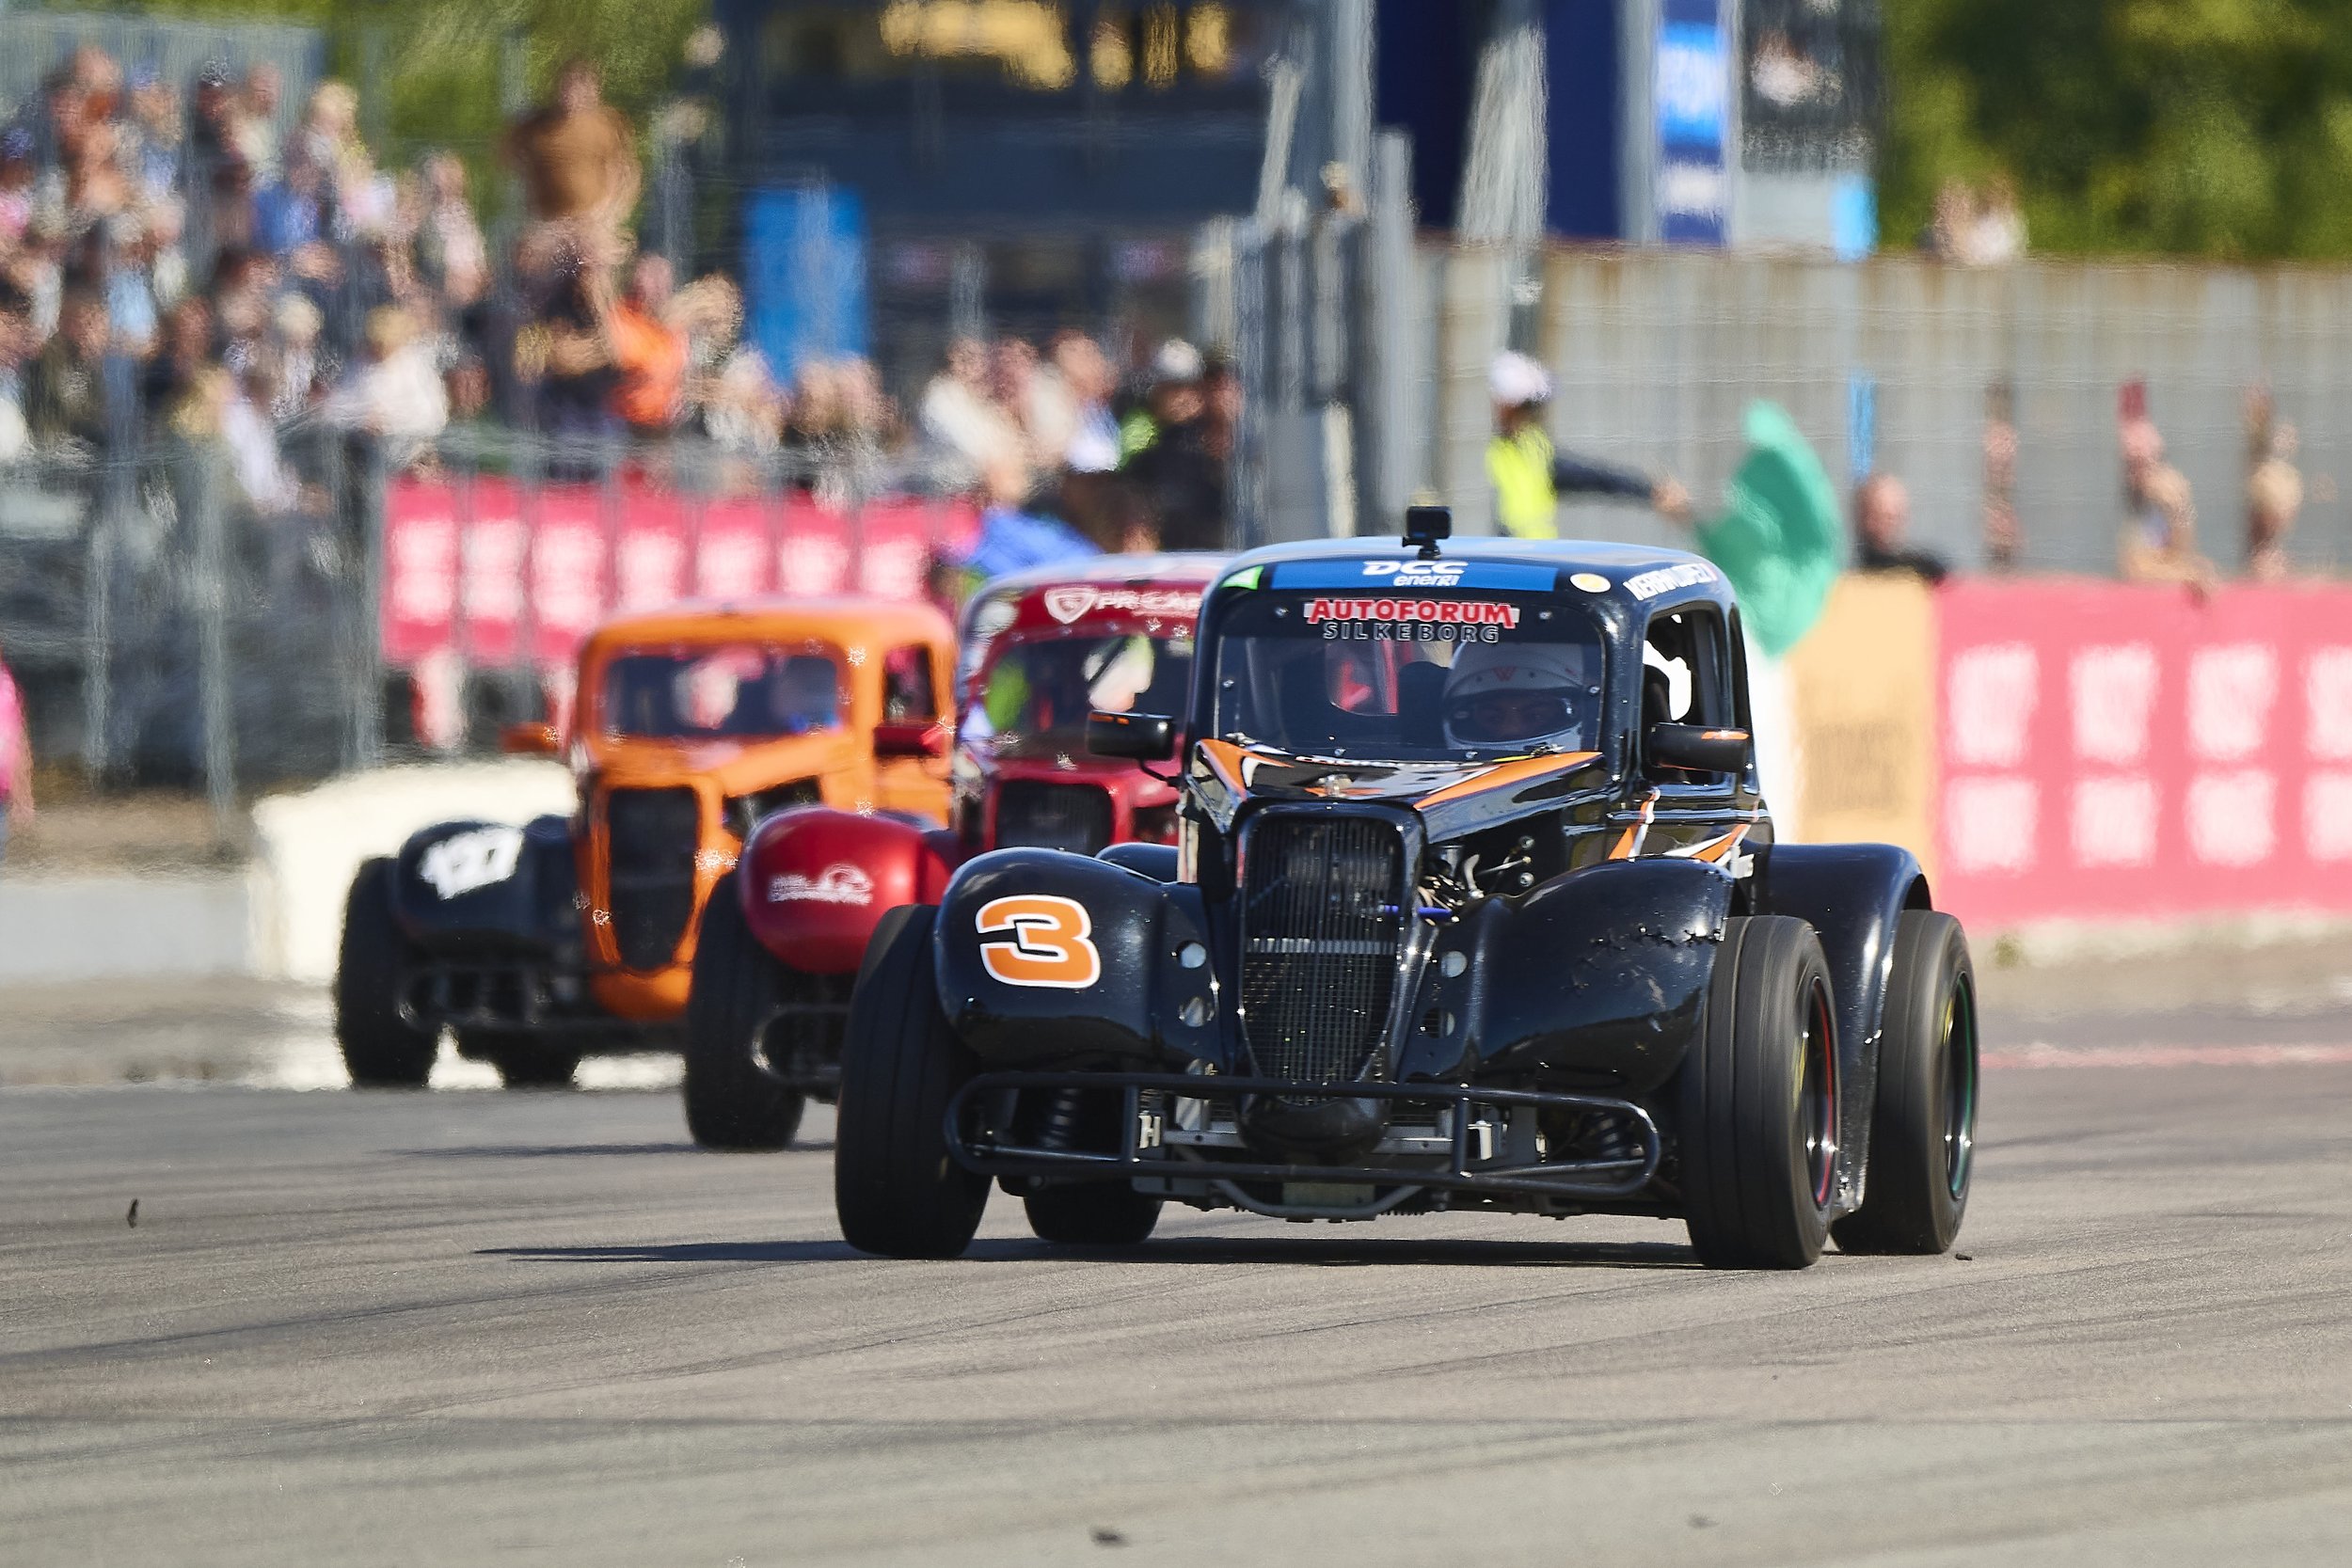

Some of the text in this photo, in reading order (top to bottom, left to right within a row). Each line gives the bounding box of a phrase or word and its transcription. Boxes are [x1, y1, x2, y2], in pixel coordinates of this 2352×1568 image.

[1362, 561, 1469, 575] DCC
[1393, 575, 1460, 587] energi
[1307, 598, 1516, 629] AUTOFORUM
[1323, 622, 1500, 642] SILKEBORG
[976, 895, 1101, 988] 3
